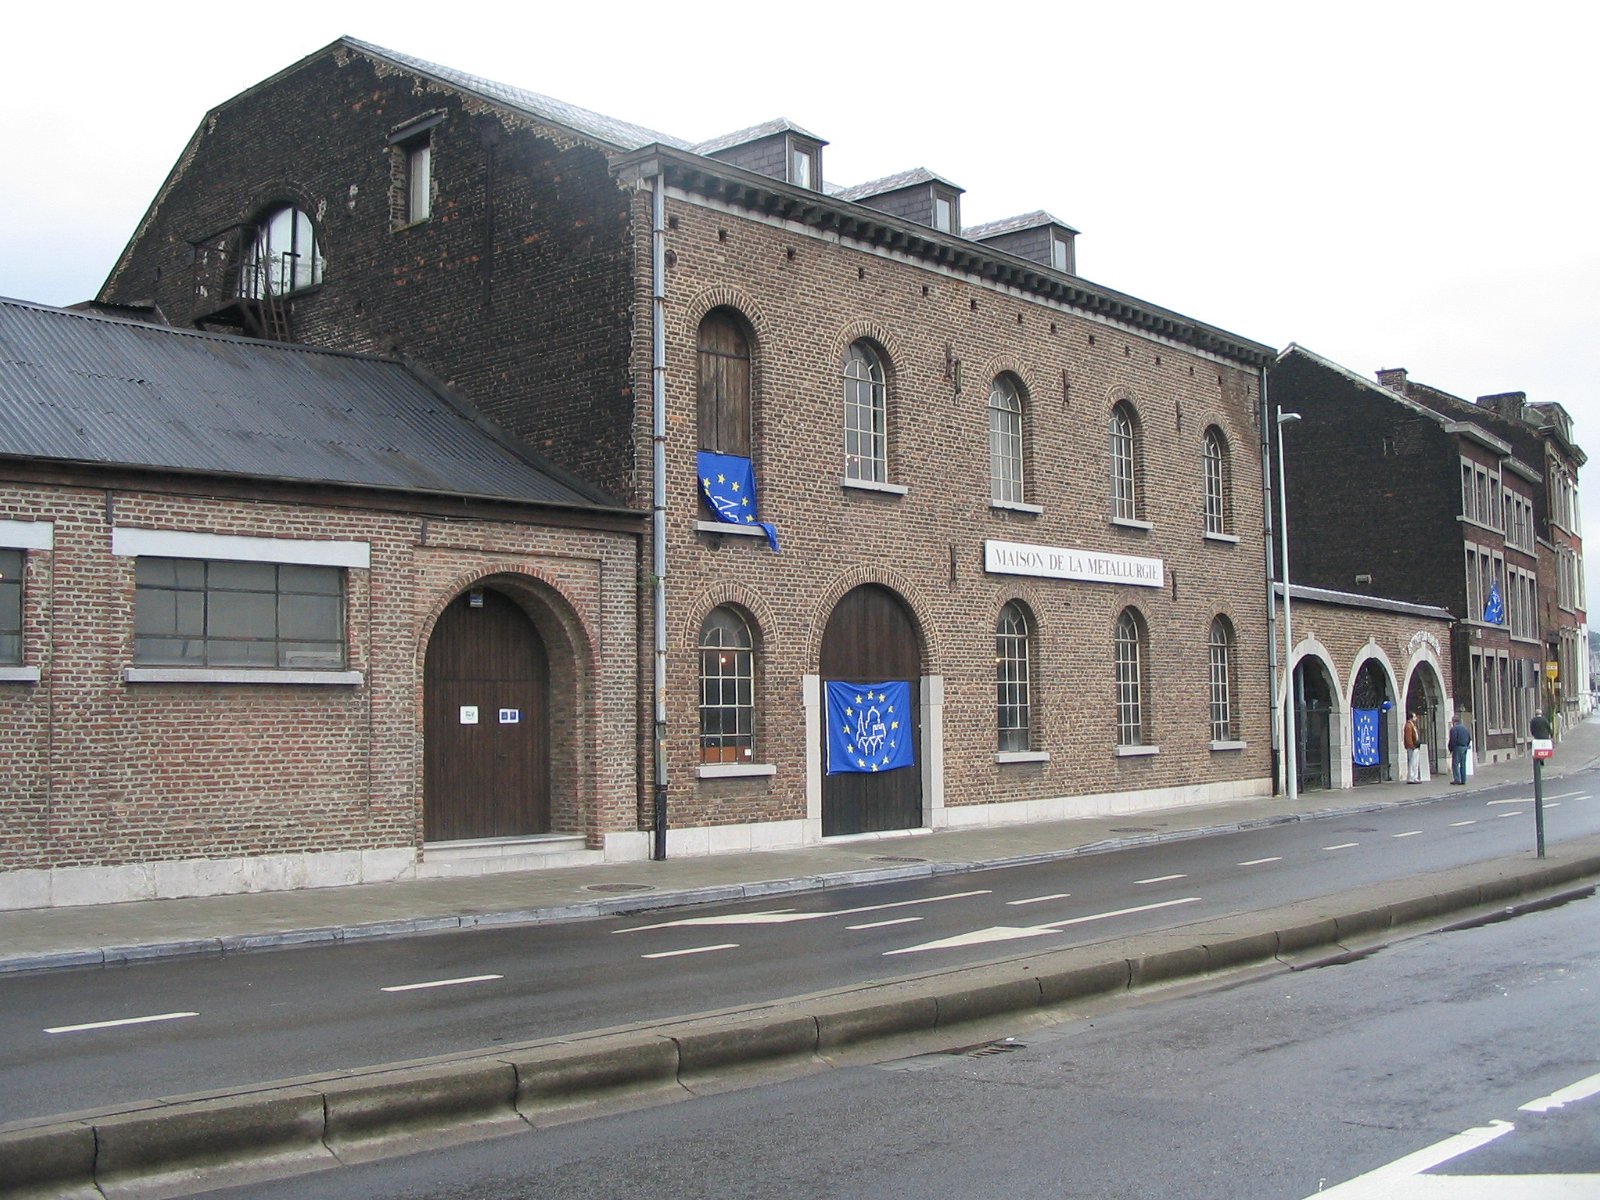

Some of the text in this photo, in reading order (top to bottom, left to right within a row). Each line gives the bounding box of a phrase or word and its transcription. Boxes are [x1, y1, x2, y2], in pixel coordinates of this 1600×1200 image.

[995, 549, 1159, 580] MAISON DE LA METALLURGIE
